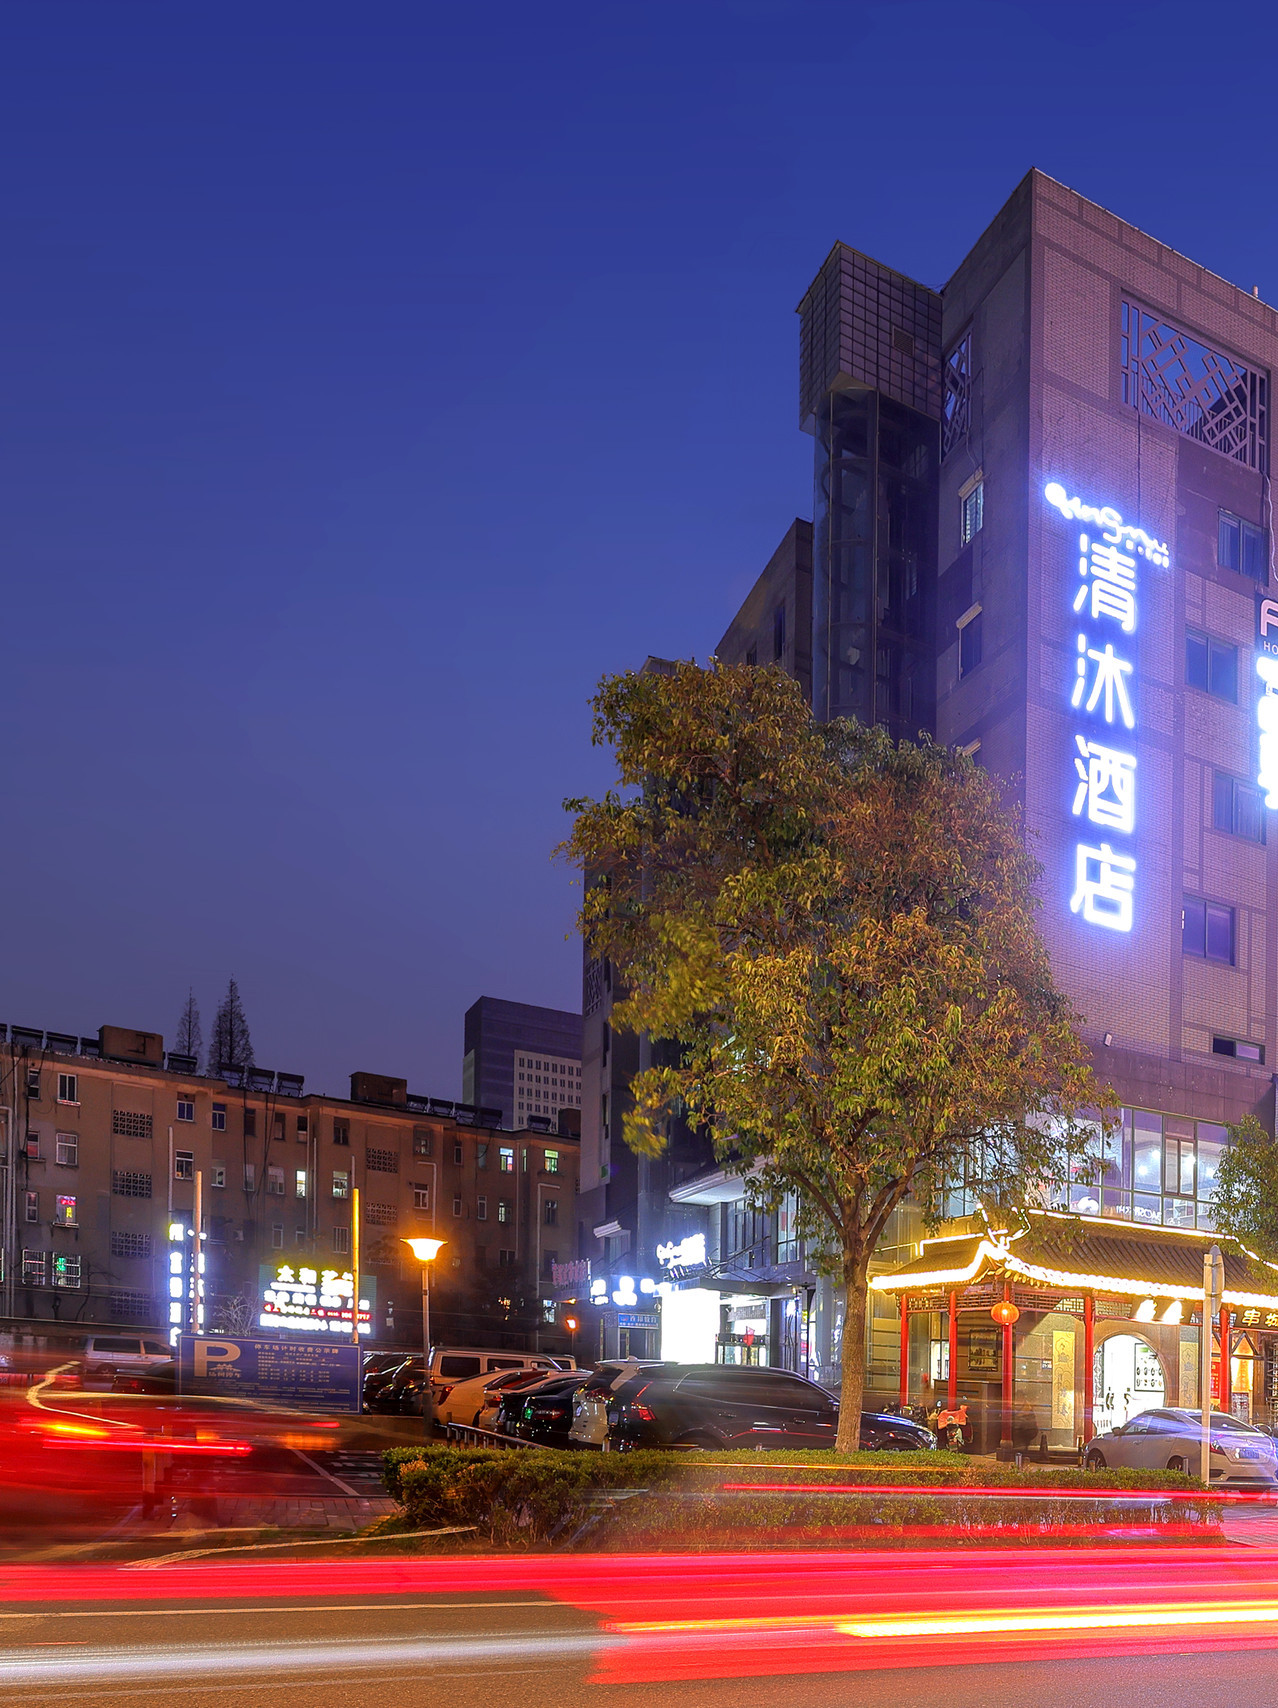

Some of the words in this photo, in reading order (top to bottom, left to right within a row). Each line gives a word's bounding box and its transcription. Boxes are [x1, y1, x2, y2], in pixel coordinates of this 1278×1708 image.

[1070, 533, 1137, 932] 清沐酒店
[194, 1340, 241, 1377] P
